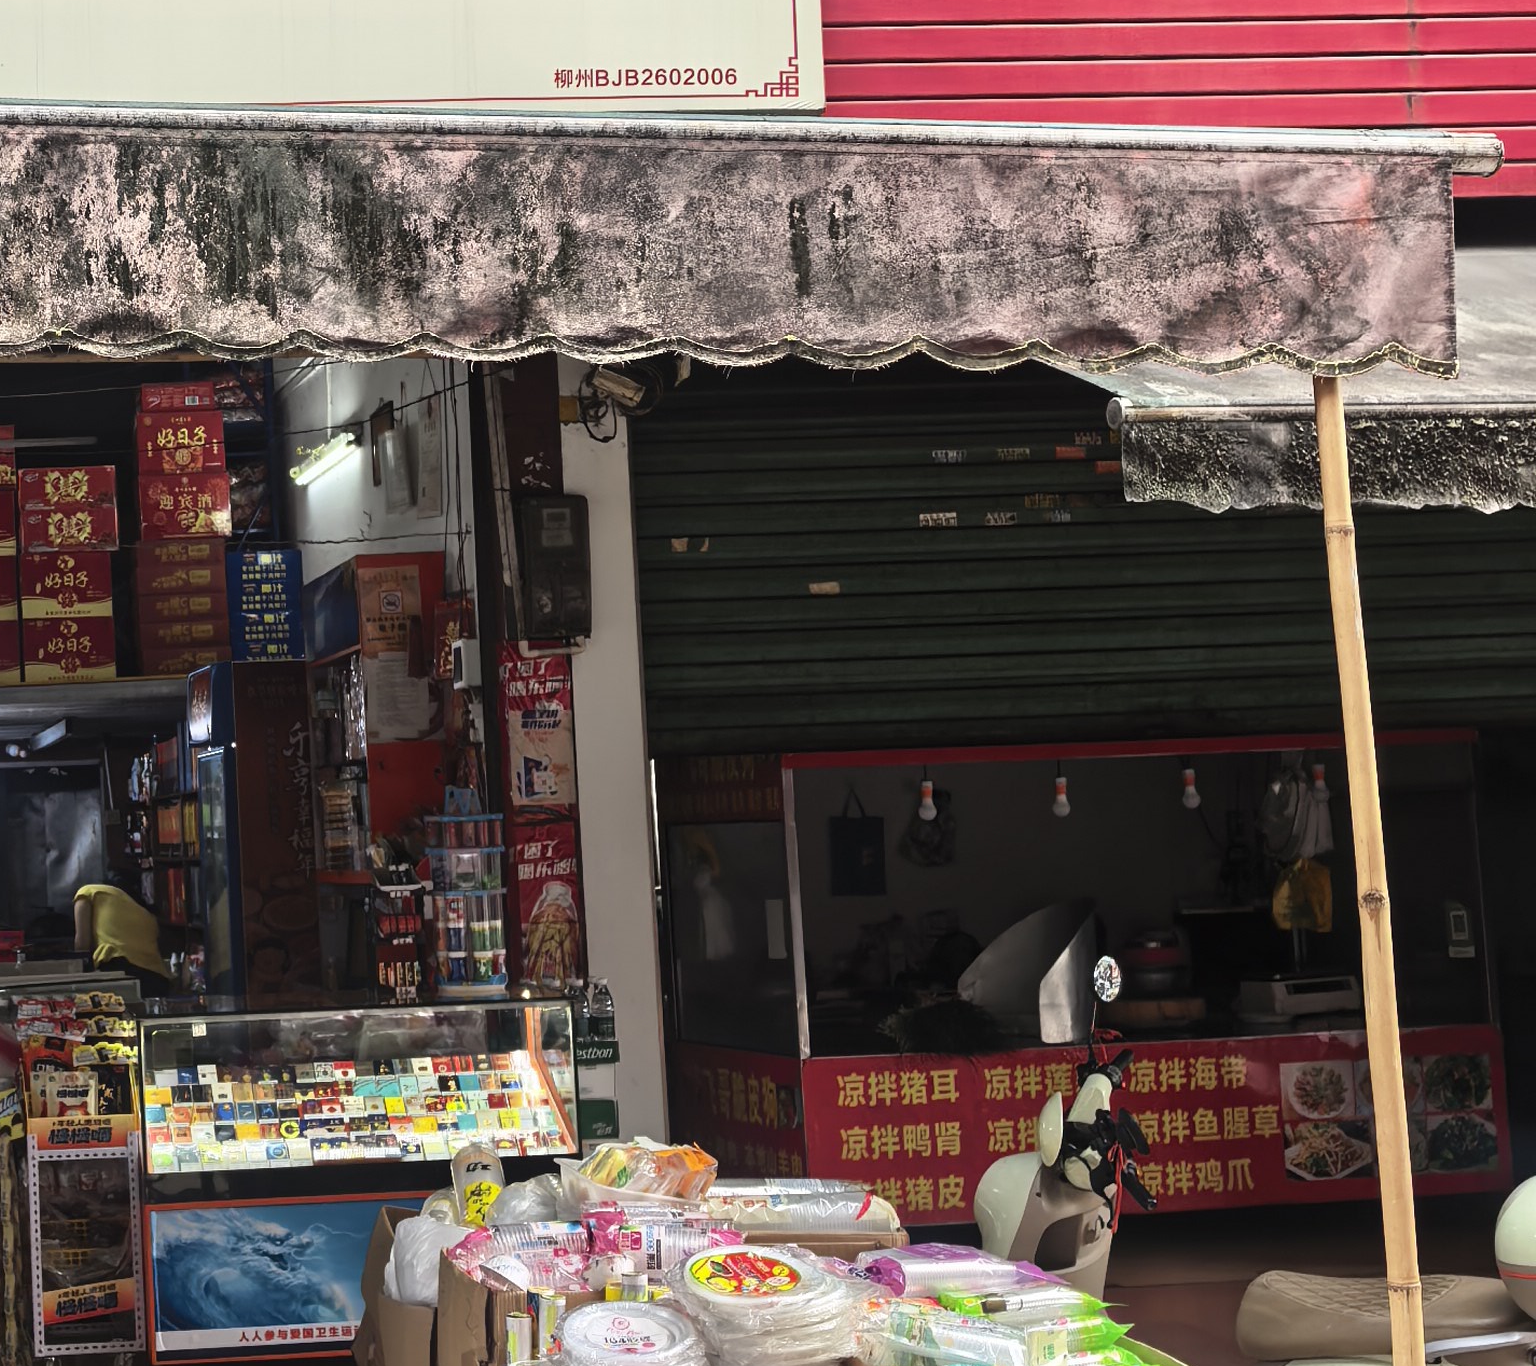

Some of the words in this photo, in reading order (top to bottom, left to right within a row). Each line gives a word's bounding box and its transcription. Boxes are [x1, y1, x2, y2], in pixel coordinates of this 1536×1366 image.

[554, 67, 738, 89] 柳州BJB2602006
[156, 426, 208, 448] 好日子
[44, 571, 90, 589] 好日子
[47, 635, 93, 653] 好日子
[836, 1067, 961, 1107] 凉拌猪耳
[983, 1062, 1078, 1101] 凉拌莲
[1129, 1055, 1249, 1094] 凉拌海带
[840, 1121, 963, 1162] 凉拌鸭肾
[866, 1175, 966, 1214] 拌猪皮
